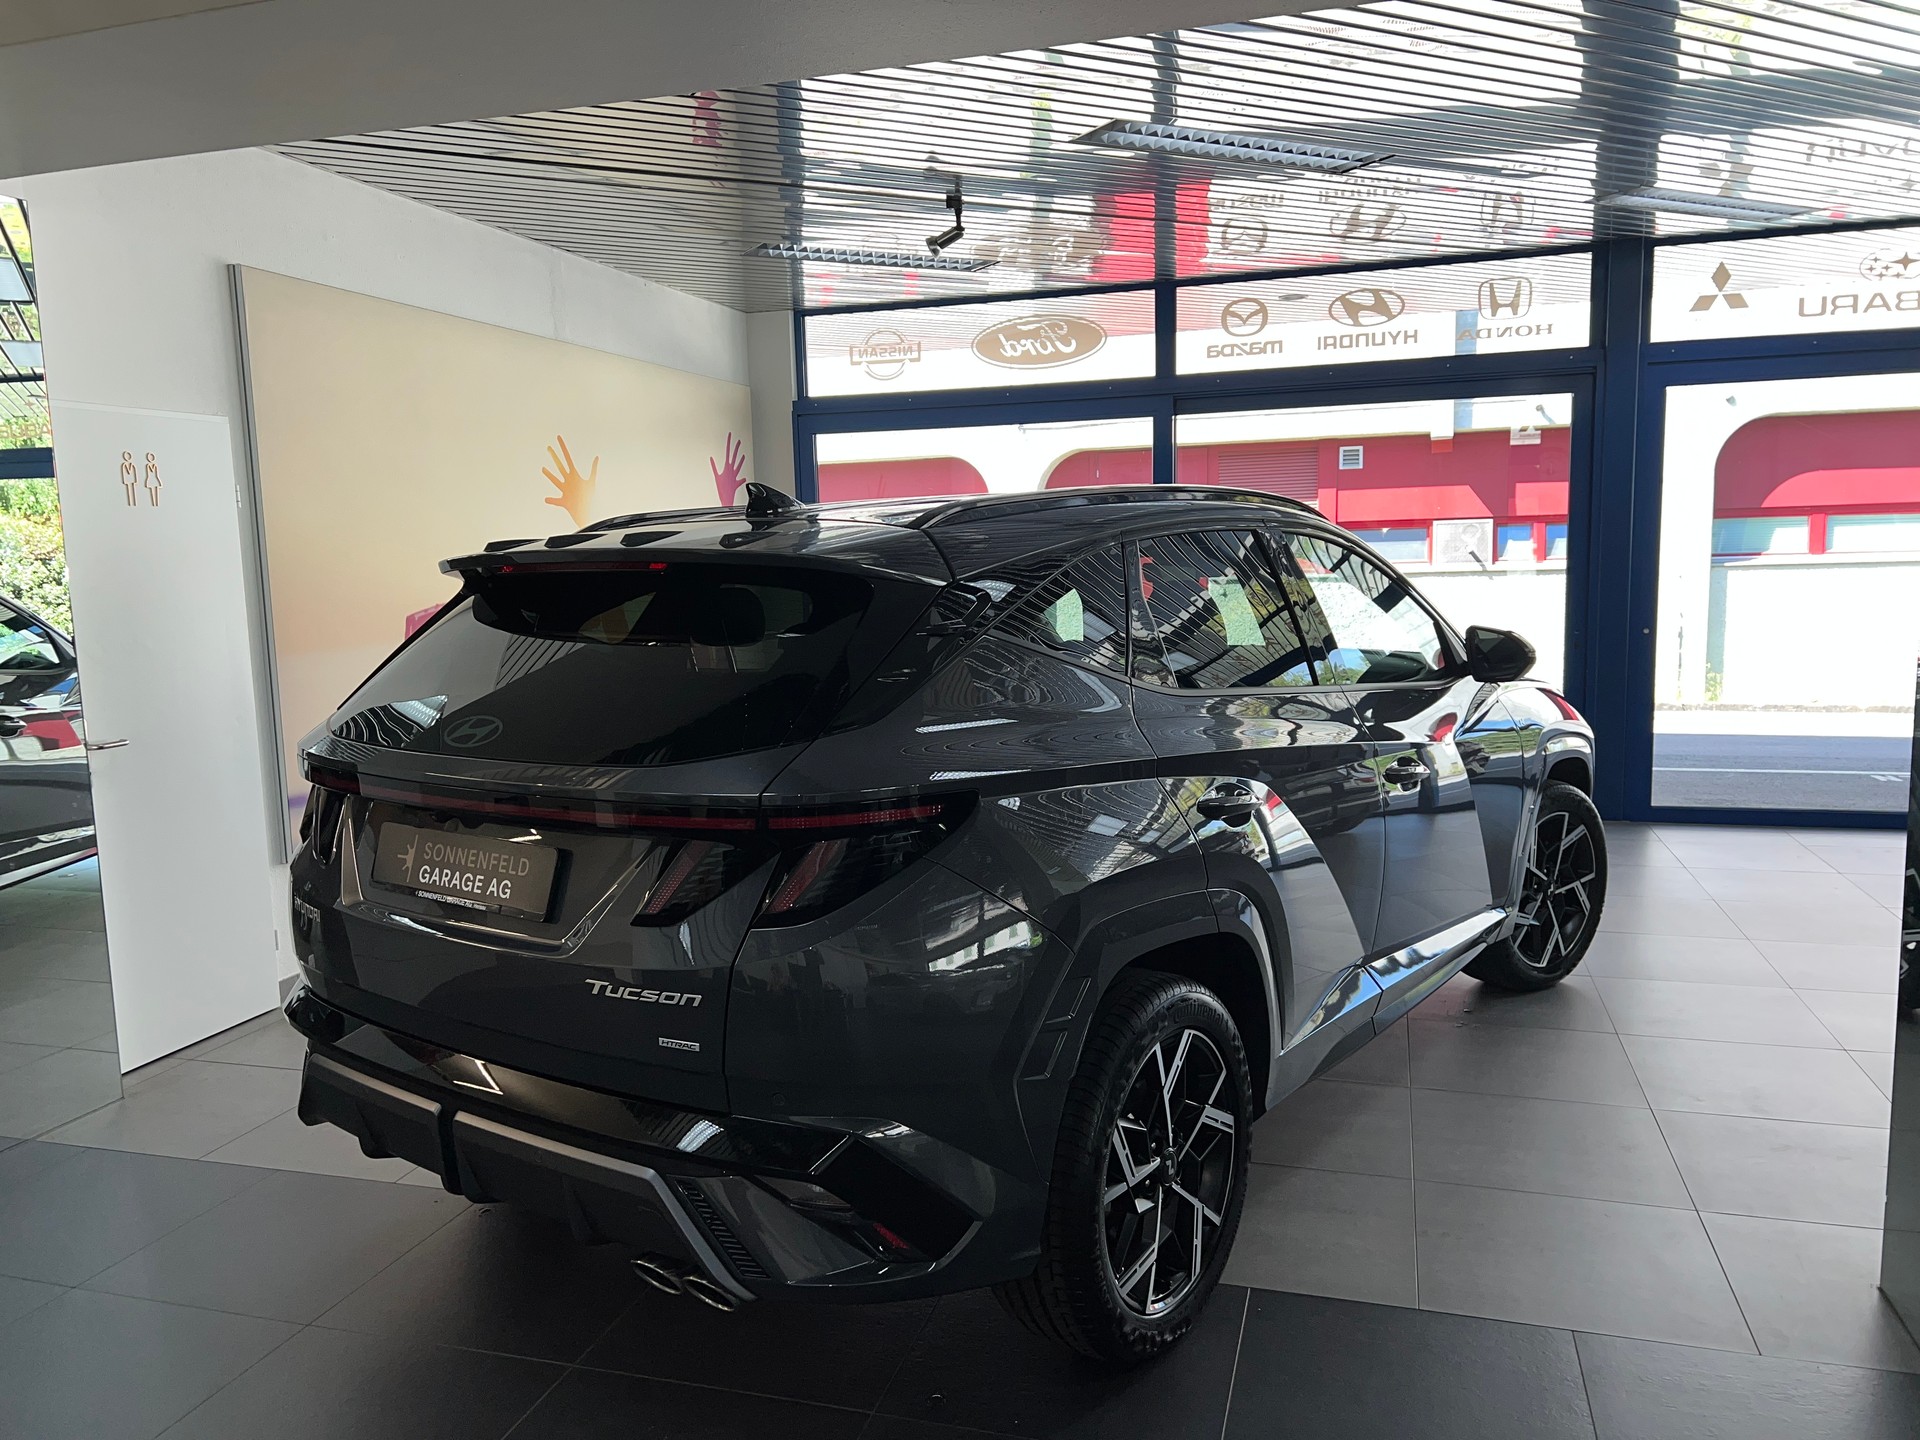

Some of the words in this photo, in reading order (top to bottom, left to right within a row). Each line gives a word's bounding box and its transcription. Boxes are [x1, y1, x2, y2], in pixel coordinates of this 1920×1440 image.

[423, 842, 530, 877] SONNENFELD
[419, 865, 484, 894] GARAGE
[486, 878, 512, 899] AG
[661, 1039, 697, 1051] HTRAC
